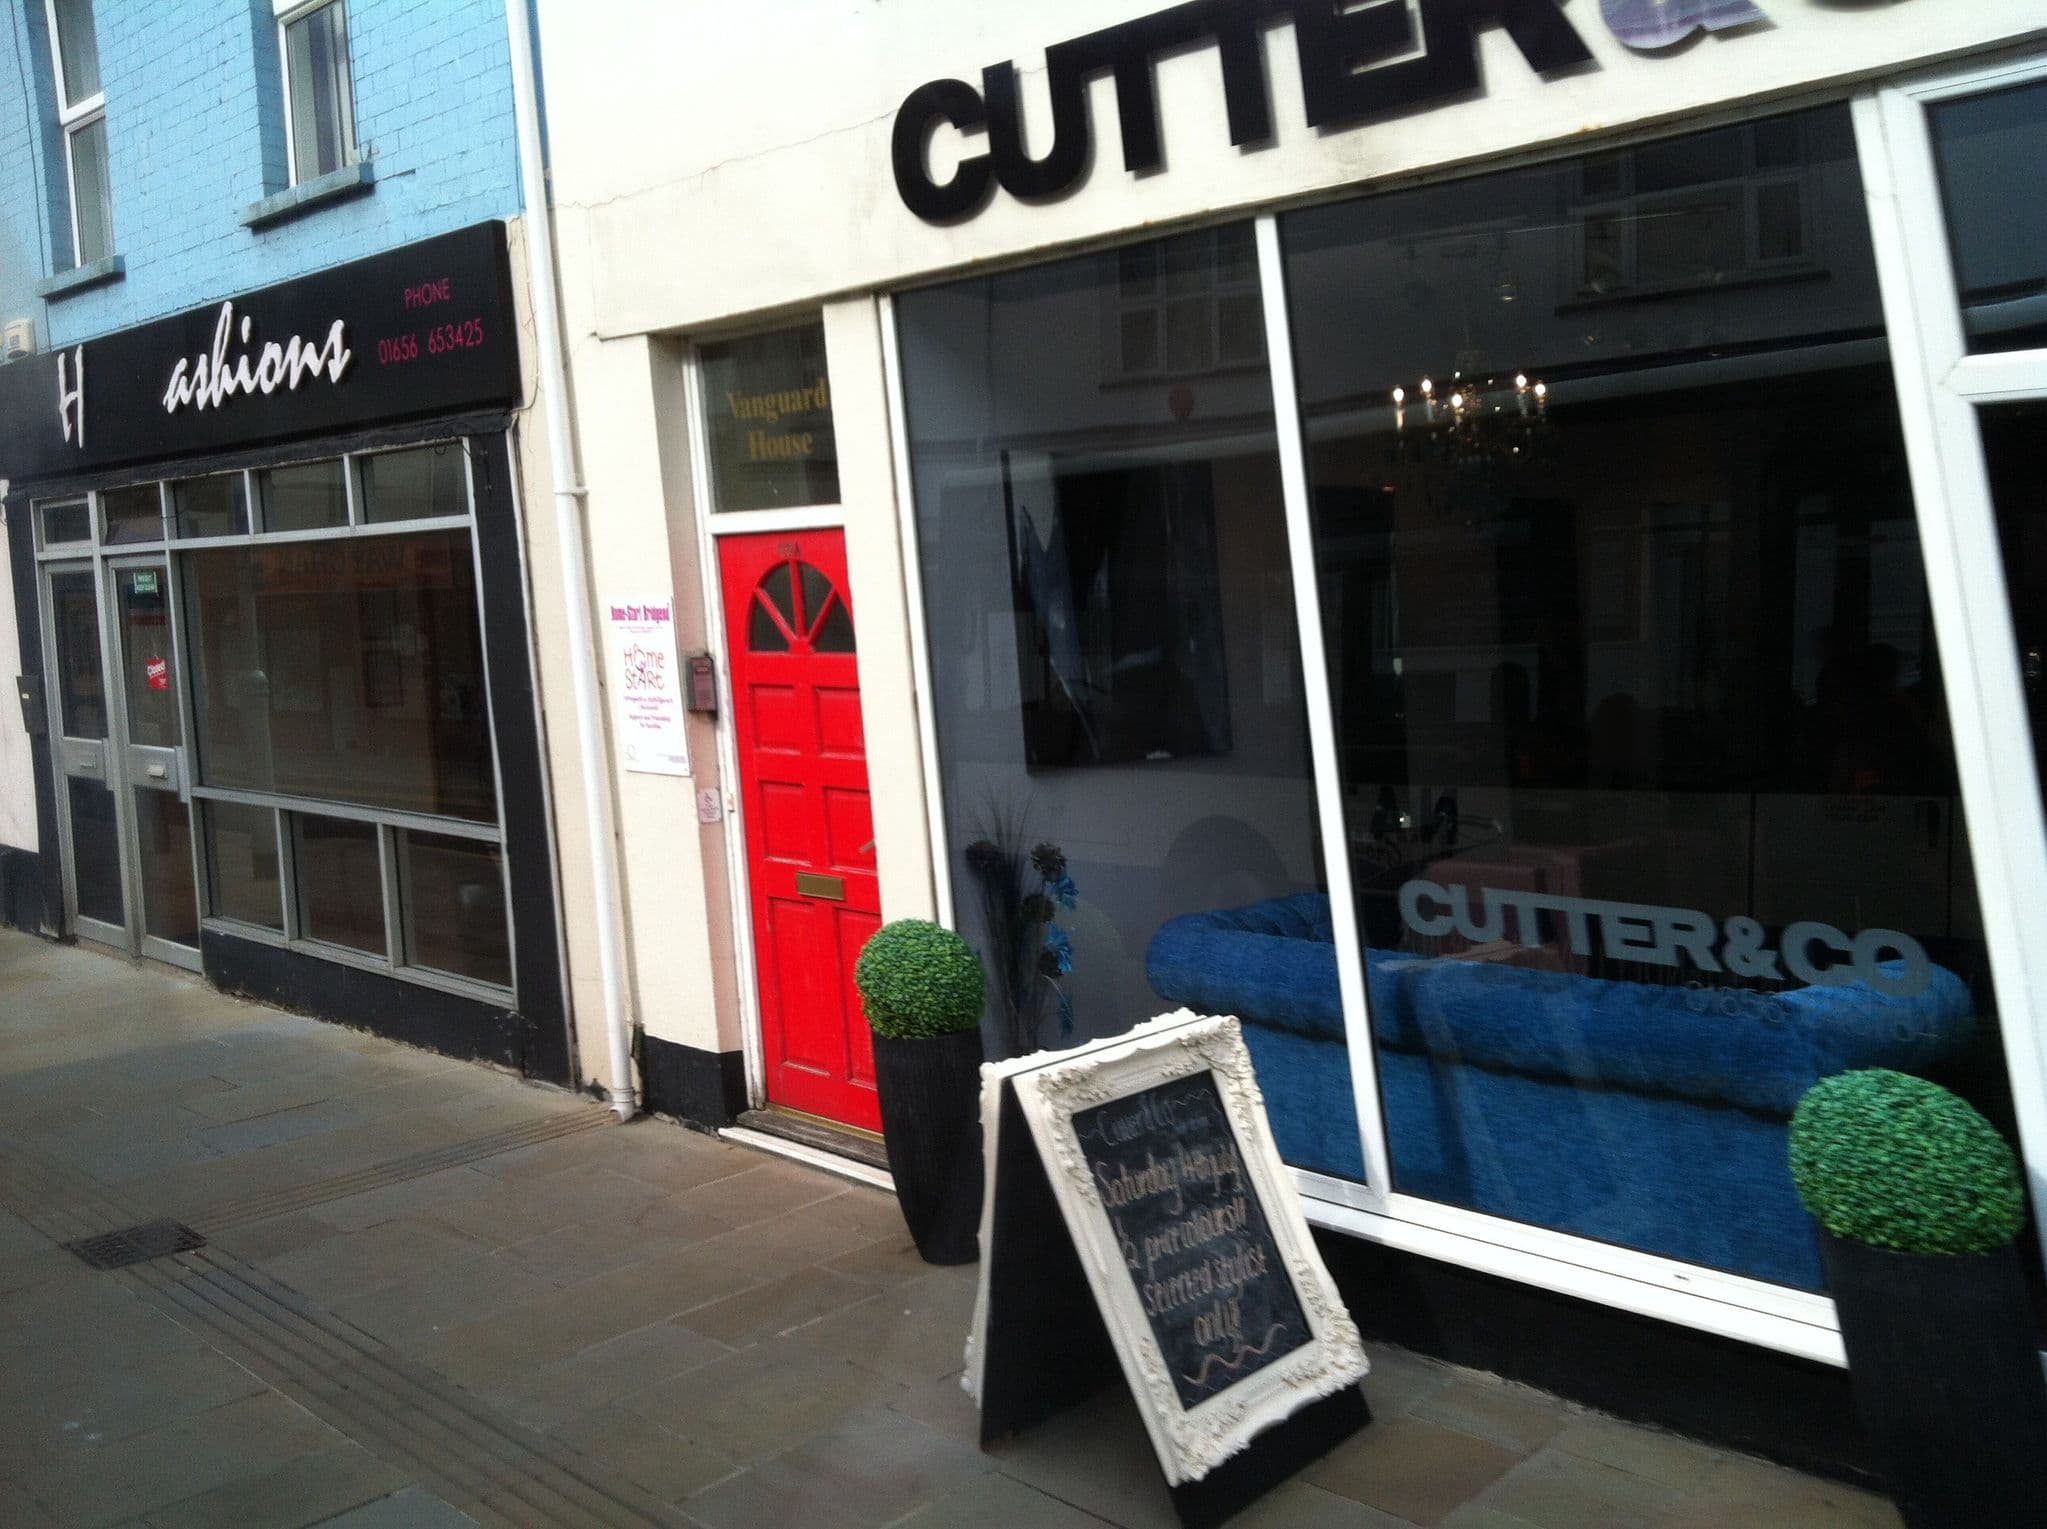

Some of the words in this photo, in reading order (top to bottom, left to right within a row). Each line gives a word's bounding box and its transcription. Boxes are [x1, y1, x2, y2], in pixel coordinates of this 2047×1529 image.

[404, 278, 451, 309] PHONE
[163, 301, 352, 414] ashions
[378, 332, 419, 366] 01656
[428, 318, 485, 354] 653425
[727, 377, 829, 424] Vanguard
[749, 431, 814, 461] House
[1399, 879, 1931, 998] CUTTER&CO
